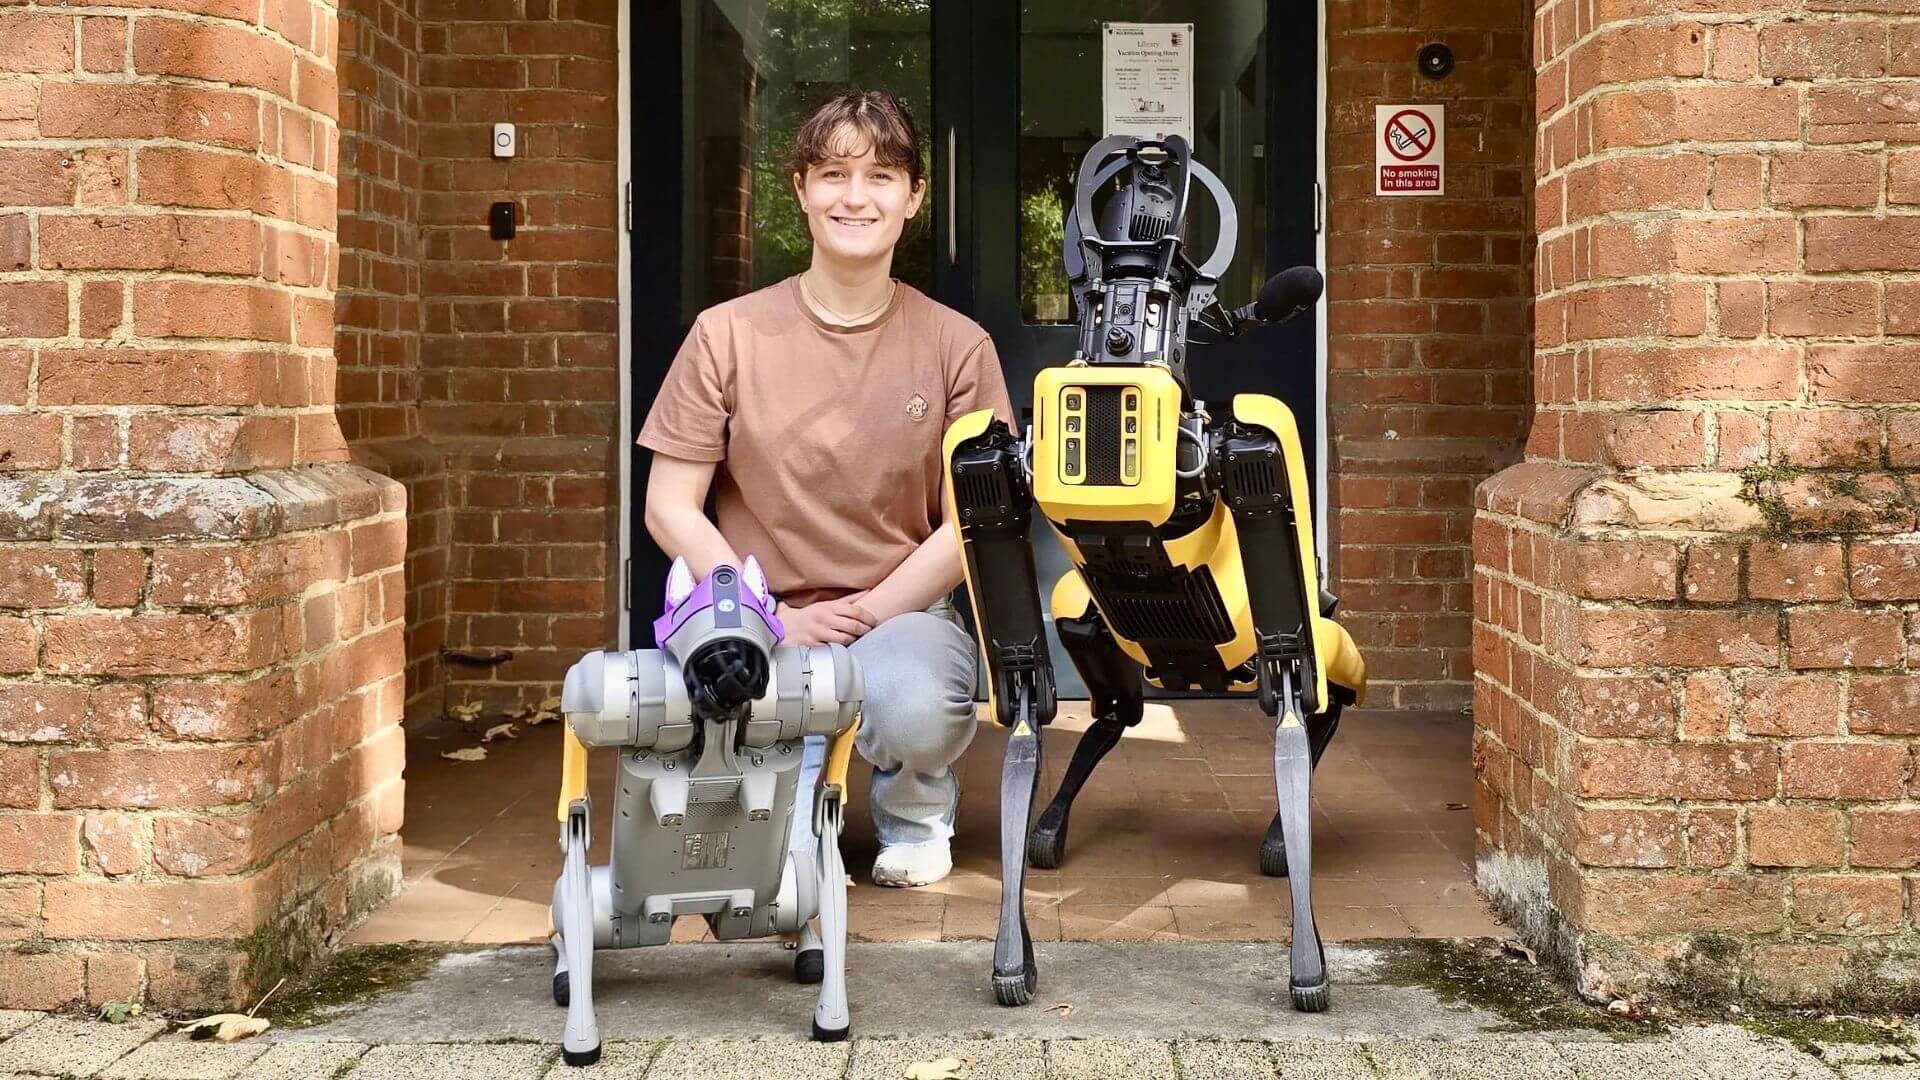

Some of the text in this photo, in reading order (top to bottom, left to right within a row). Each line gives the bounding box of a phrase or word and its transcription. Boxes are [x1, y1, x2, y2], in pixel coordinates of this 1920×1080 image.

[1137, 40, 1160, 49] Library
[1382, 168, 1438, 179] No smoking
[1384, 178, 1437, 187] in this area
